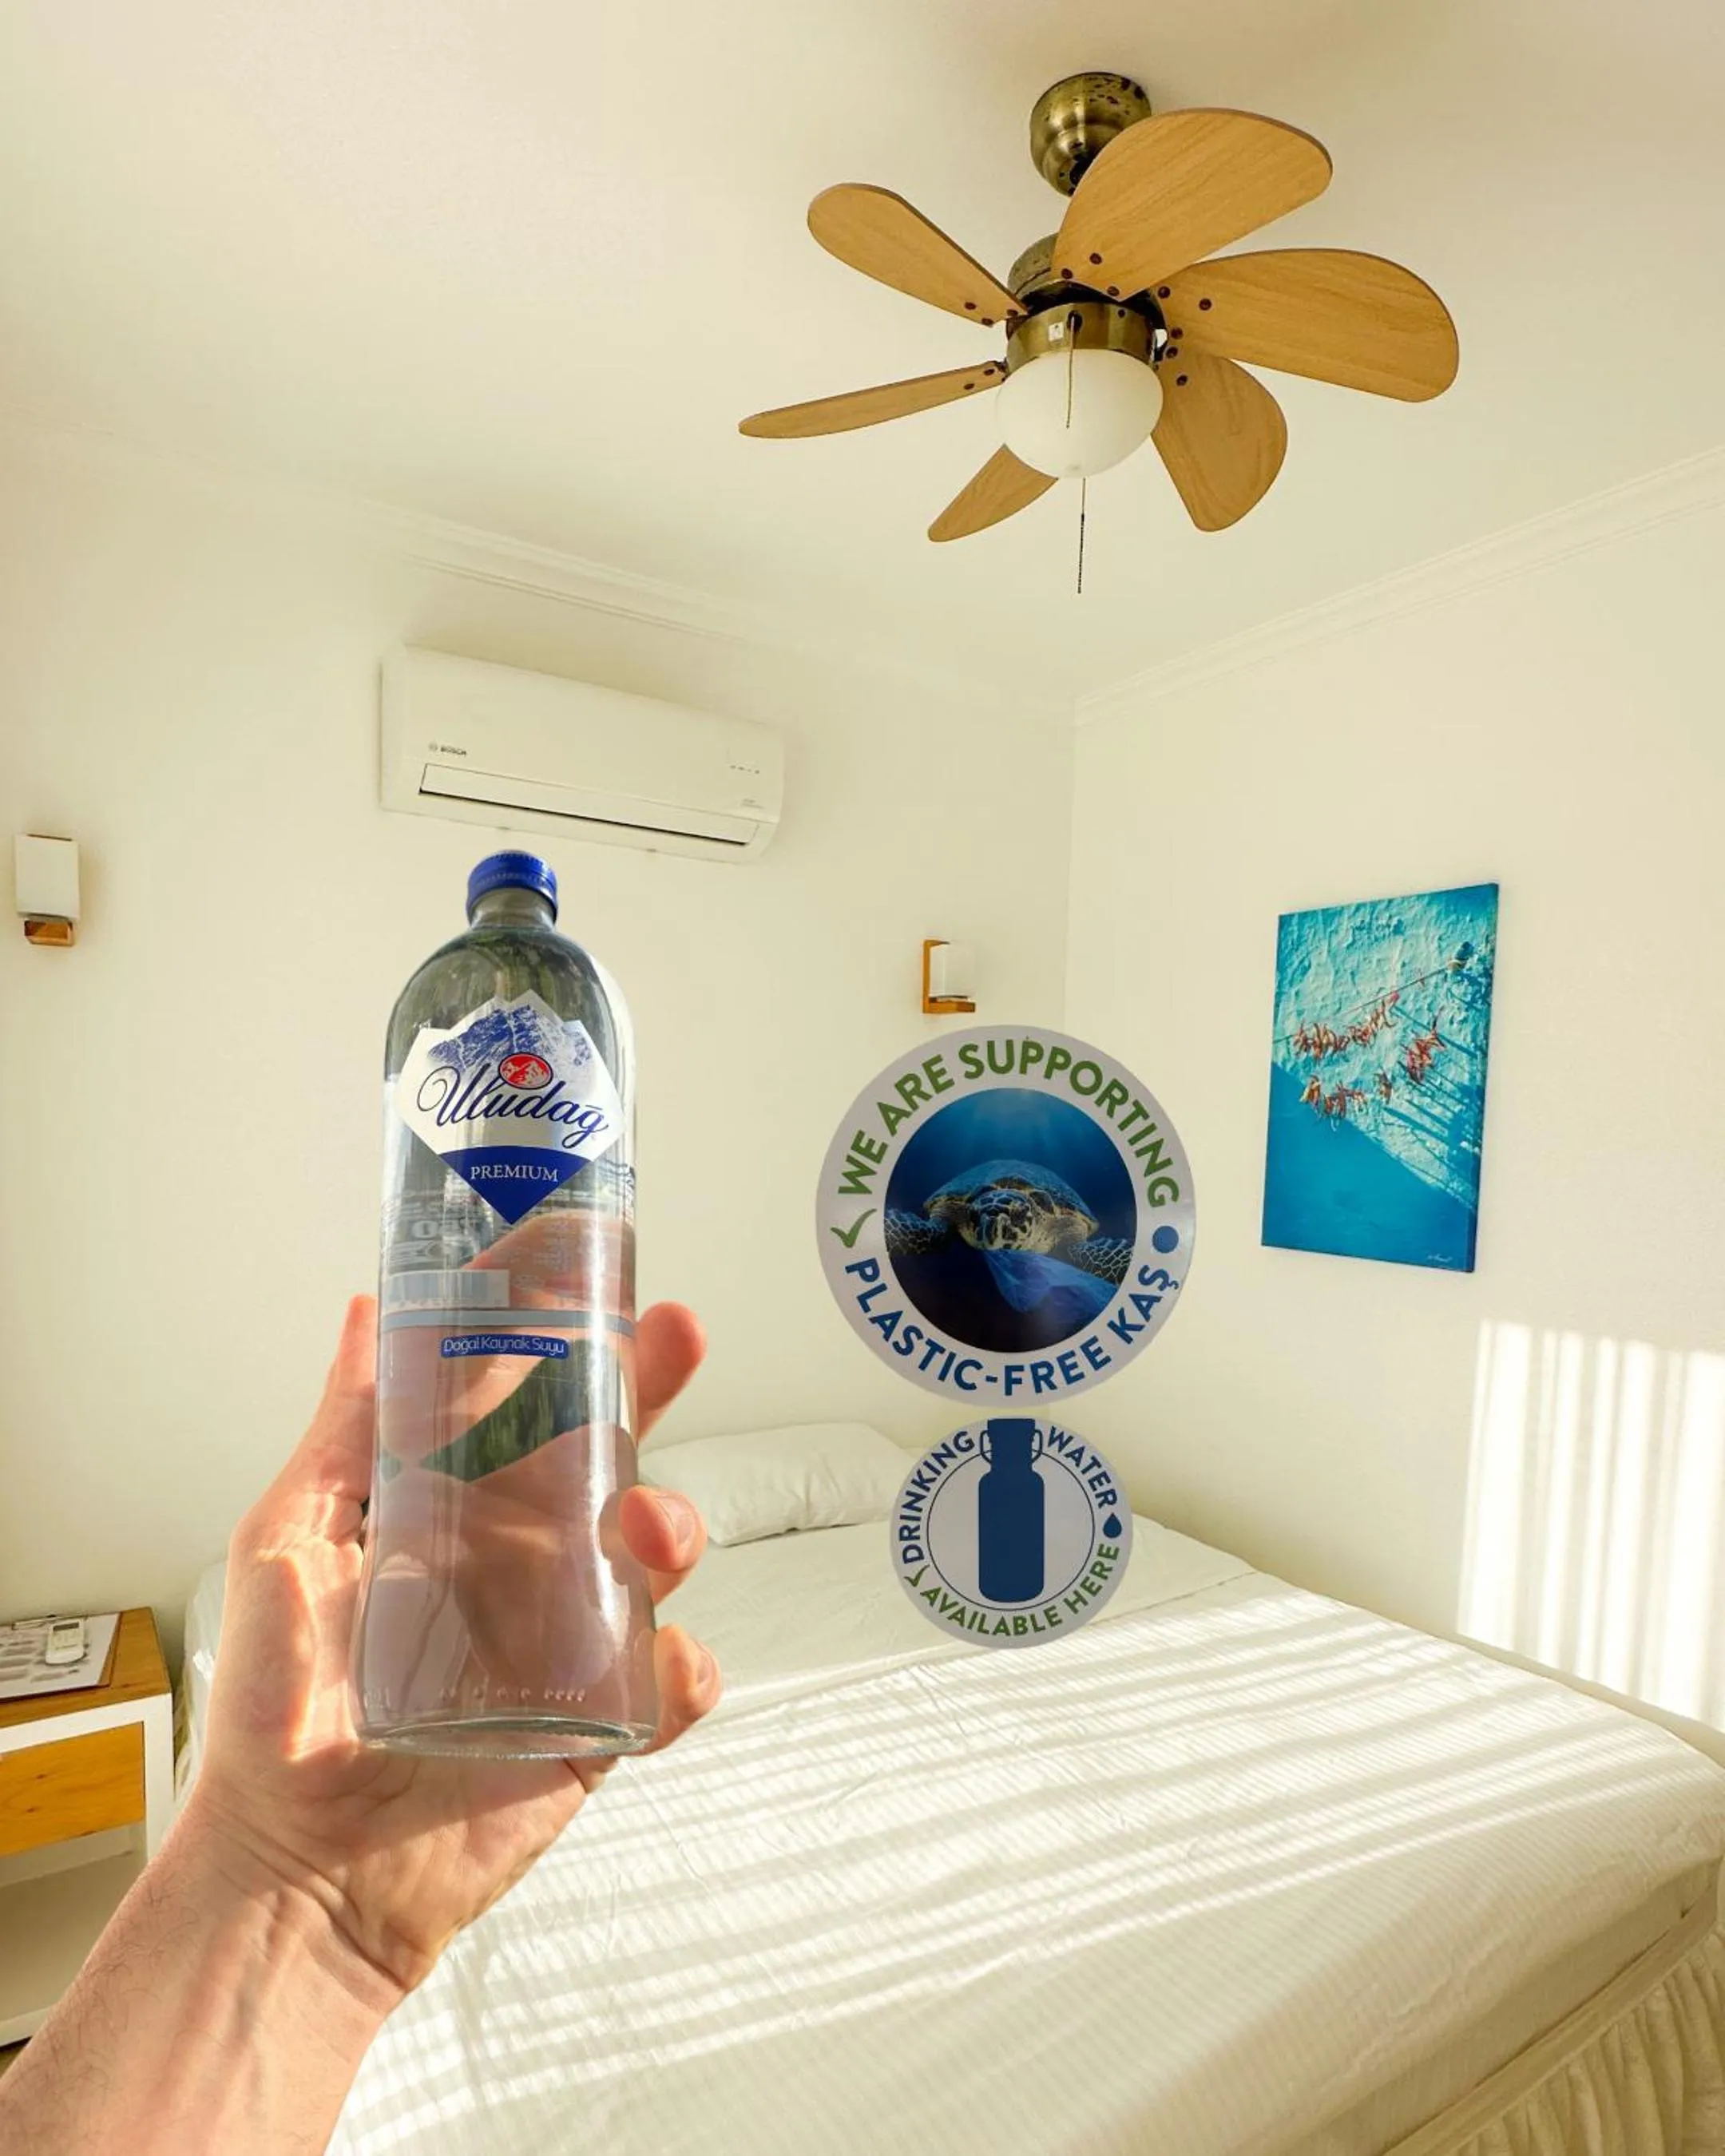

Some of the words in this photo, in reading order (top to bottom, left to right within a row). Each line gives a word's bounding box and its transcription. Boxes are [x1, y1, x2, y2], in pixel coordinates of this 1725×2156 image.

[470, 1164, 559, 1183] PREMIUM
[837, 1130, 888, 1195] WE
[877, 1053, 956, 1136] ARE
[958, 1039, 1180, 1208] SUPPORTING
[443, 1338, 479, 1355] Doğal
[481, 1336, 530, 1353] Kaynak
[532, 1338, 565, 1356] Suyu
[845, 1258, 1112, 1397] PLASTIC-FREE
[1107, 1264, 1180, 1345] KAŞ
[898, 1430, 975, 1564] DRINKING
[1047, 1425, 1118, 1509] WATER
[920, 1586, 1064, 1636] AVAILABLE
[1064, 1544, 1120, 1615] HERE
